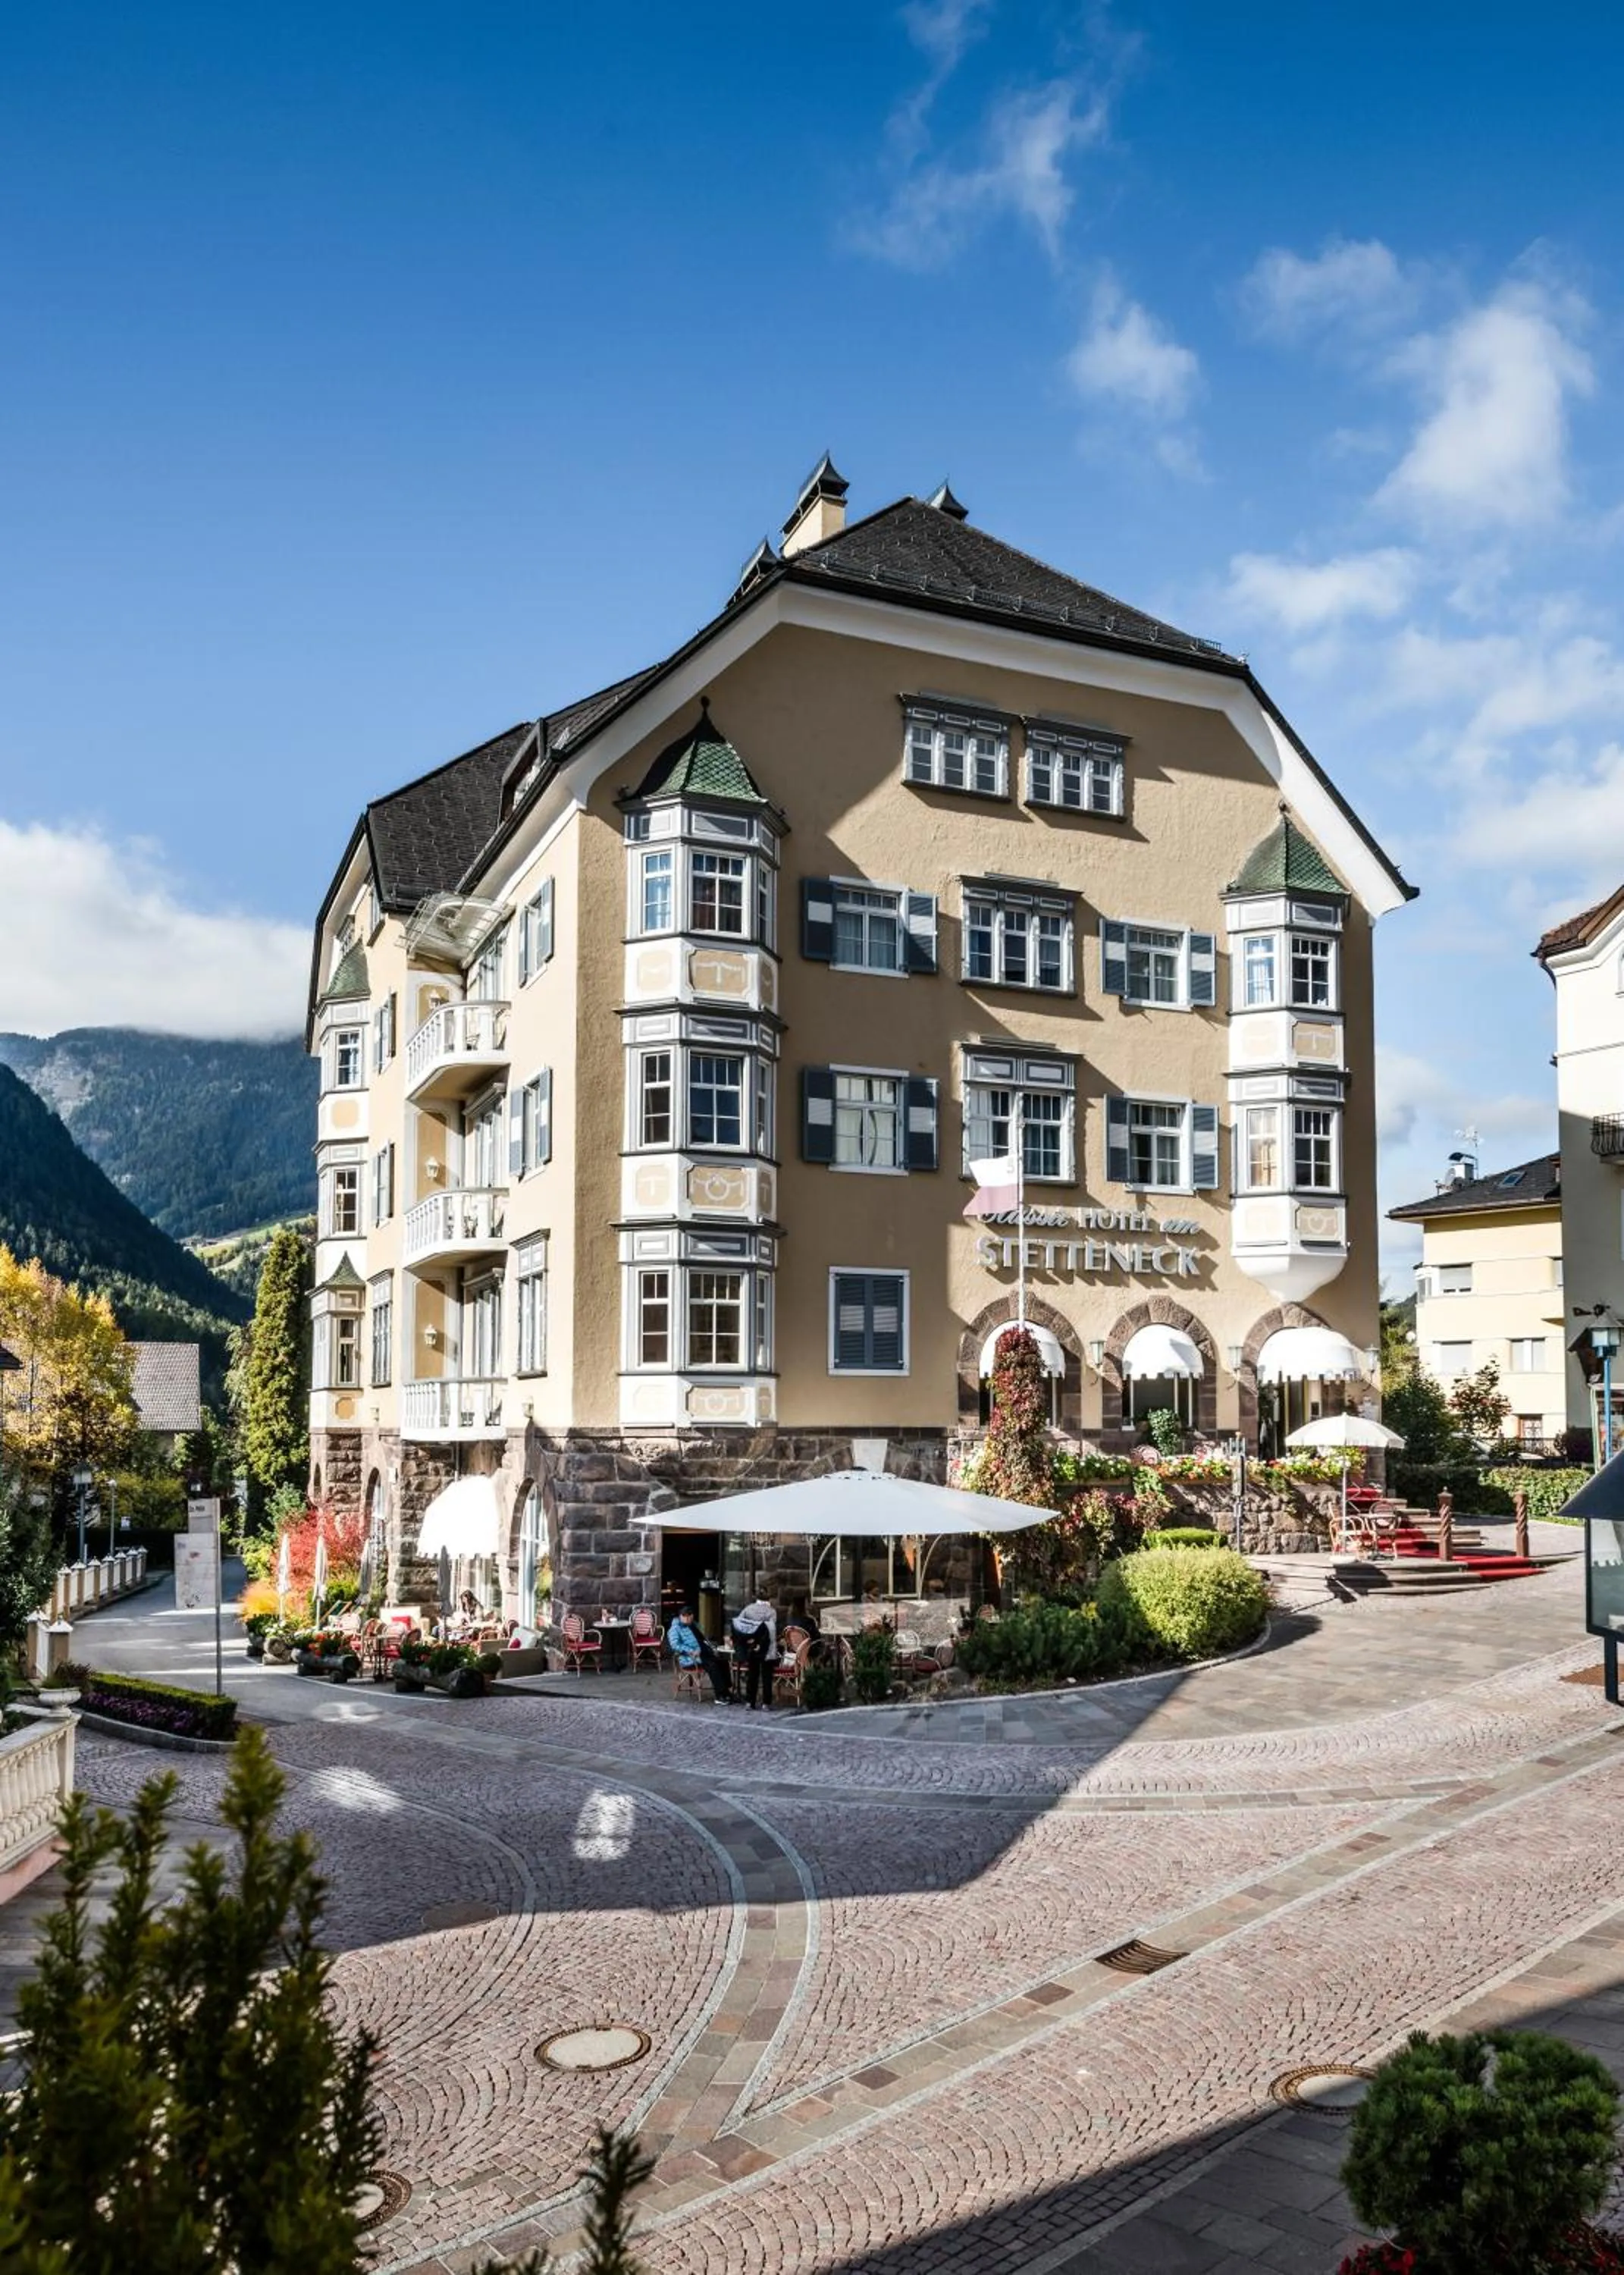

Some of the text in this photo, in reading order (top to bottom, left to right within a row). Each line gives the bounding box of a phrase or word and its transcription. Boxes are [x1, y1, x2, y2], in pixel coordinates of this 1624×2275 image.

[1077, 1207, 1152, 1232] HOTEL
[1160, 1217, 1200, 1235] am
[975, 1236, 1201, 1276] STETTENECK
